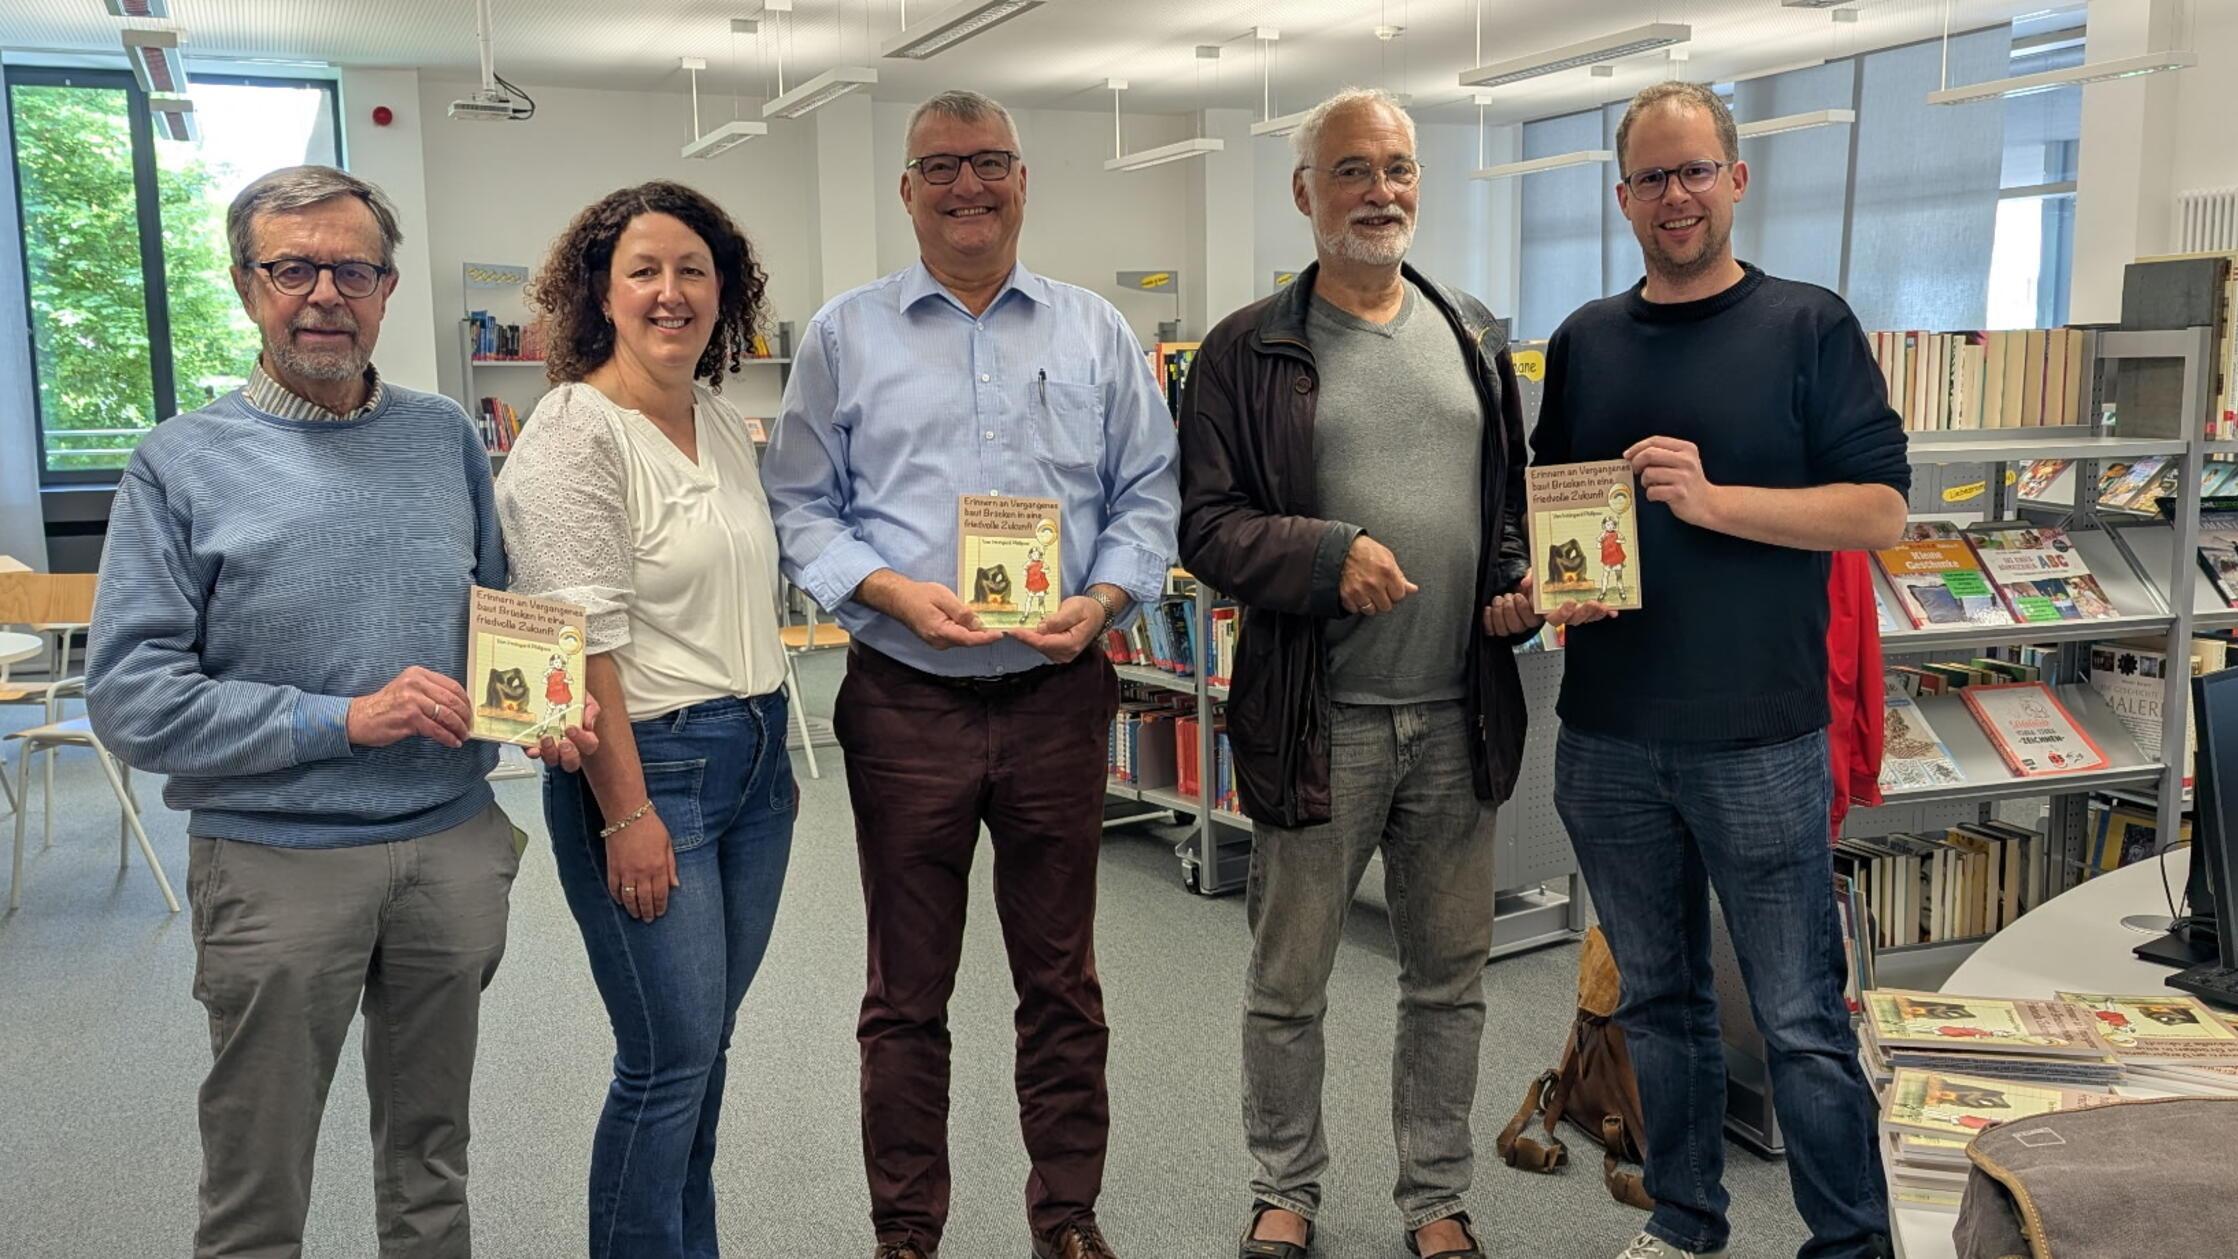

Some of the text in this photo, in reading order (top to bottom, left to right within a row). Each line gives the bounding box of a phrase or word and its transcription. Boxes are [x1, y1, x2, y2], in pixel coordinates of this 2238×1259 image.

[1530, 464, 1631, 480] Erinnern an Vergangenes
[1532, 476, 1615, 492] baut Brücken in eine
[963, 497, 998, 506] Erinnern
[1010, 499, 1059, 510] Vergangenes
[1571, 489, 1604, 502] Zukunft
[1000, 521, 1033, 531] Zukunft
[2037, 554, 2069, 569] ABC
[476, 590, 584, 618] Erinnern an Vergangenes
[477, 603, 497, 613] baut
[537, 612, 546, 622] in
[548, 616, 566, 626] eine
[476, 614, 555, 636] friedvolle Zukunft
